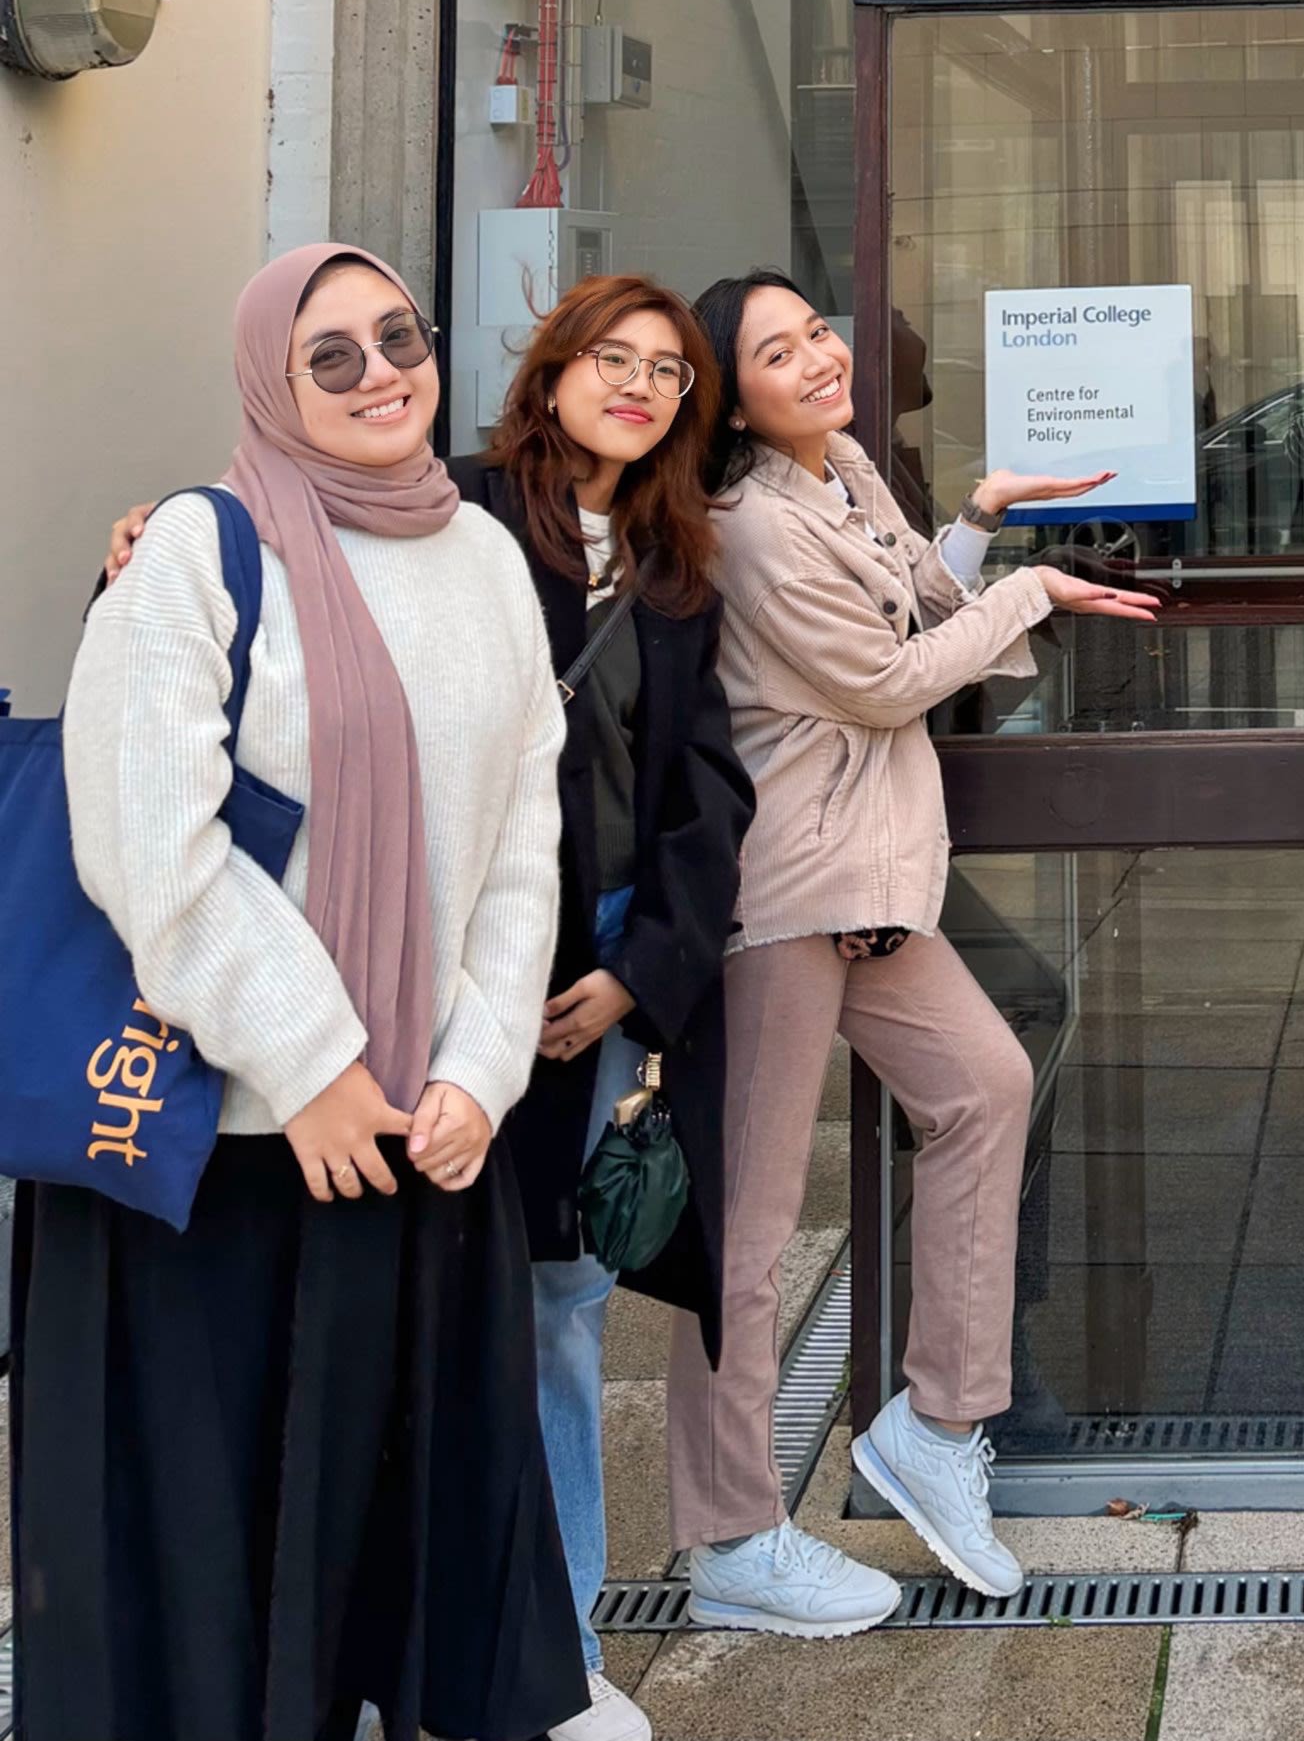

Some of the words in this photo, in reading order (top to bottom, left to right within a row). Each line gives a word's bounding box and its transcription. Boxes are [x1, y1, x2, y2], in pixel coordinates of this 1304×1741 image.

[1001, 307, 1077, 330] Imperial
[1083, 305, 1152, 327] College
[1001, 329, 1078, 348] London
[1027, 387, 1075, 403] Centre
[1078, 385, 1100, 401] for
[1027, 404, 1135, 423] Environmental
[1027, 426, 1073, 444] Policy
